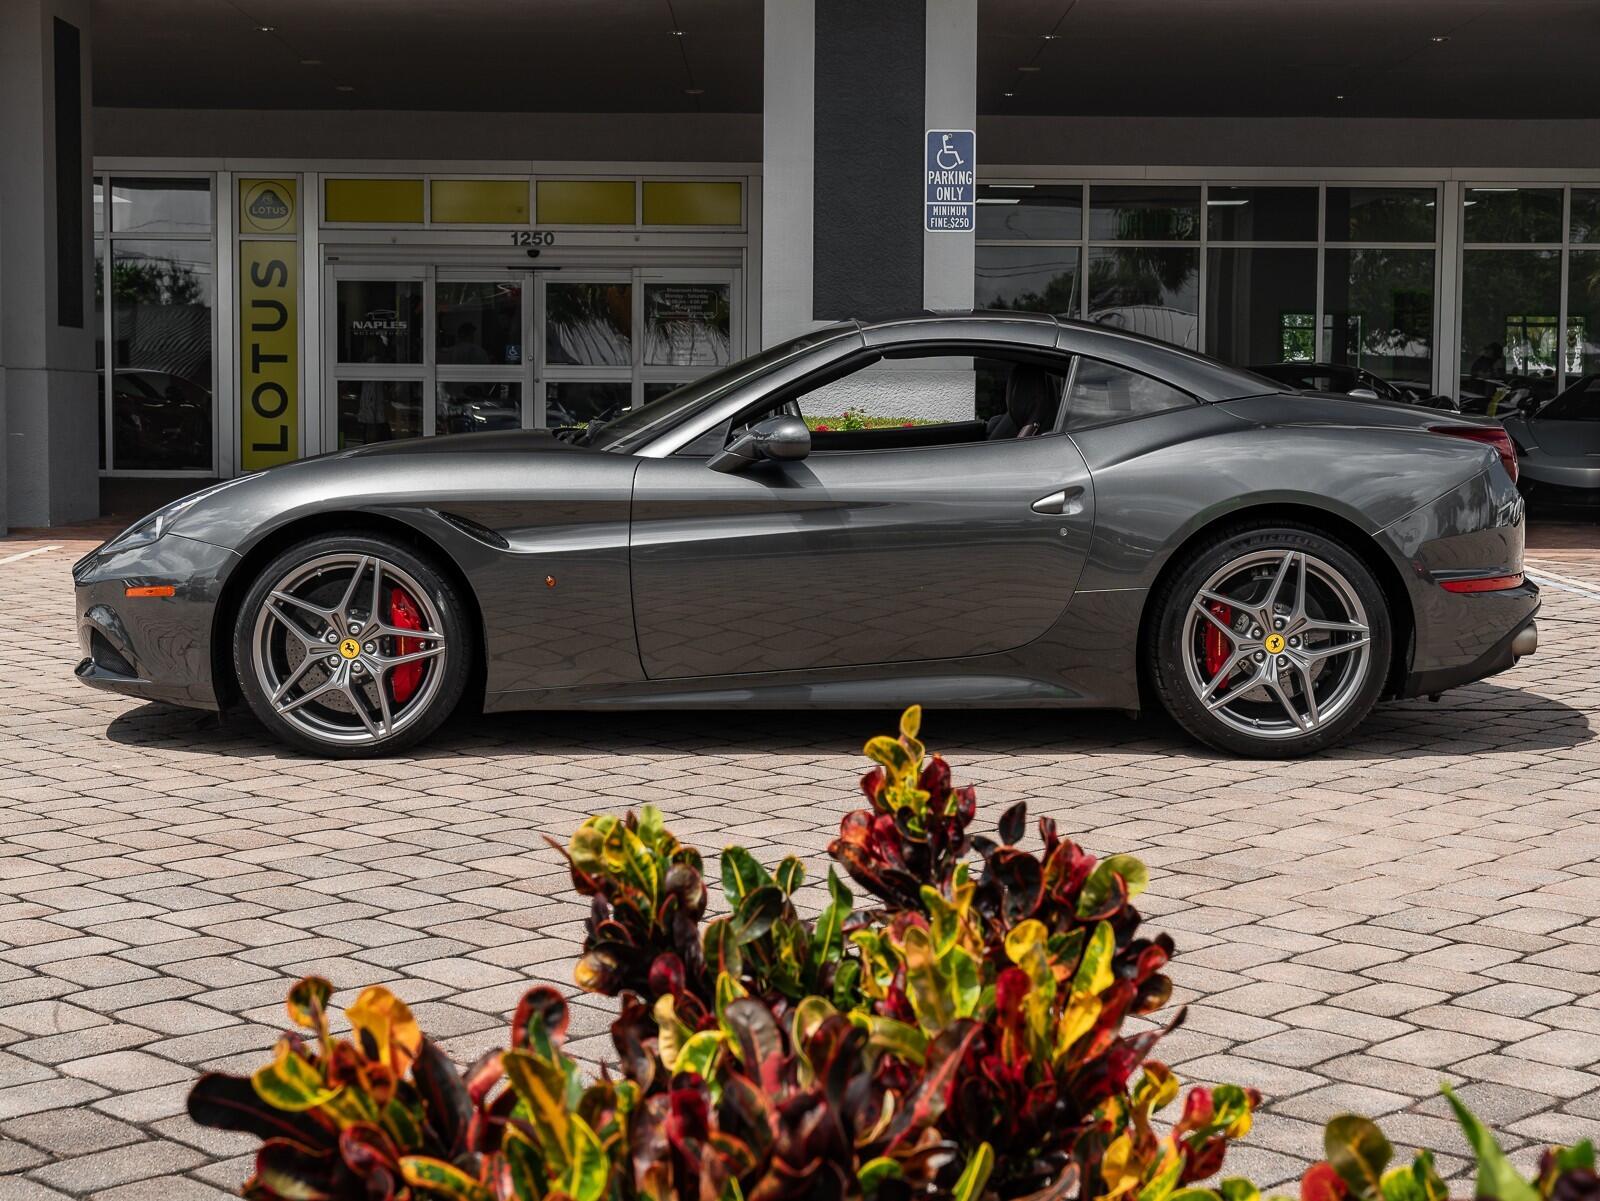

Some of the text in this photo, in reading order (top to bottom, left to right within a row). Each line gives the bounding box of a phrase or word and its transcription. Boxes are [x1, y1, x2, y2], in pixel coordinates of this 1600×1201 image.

[928, 170, 973, 185] PARKING
[936, 186, 964, 201] ONLY
[252, 206, 287, 215] LOTUS
[933, 206, 967, 216] MINIMUM
[930, 217, 969, 229] FINE $250
[511, 231, 555, 246] 1250
[353, 320, 408, 329] NAPLES
[250, 259, 289, 452] LOTUS
